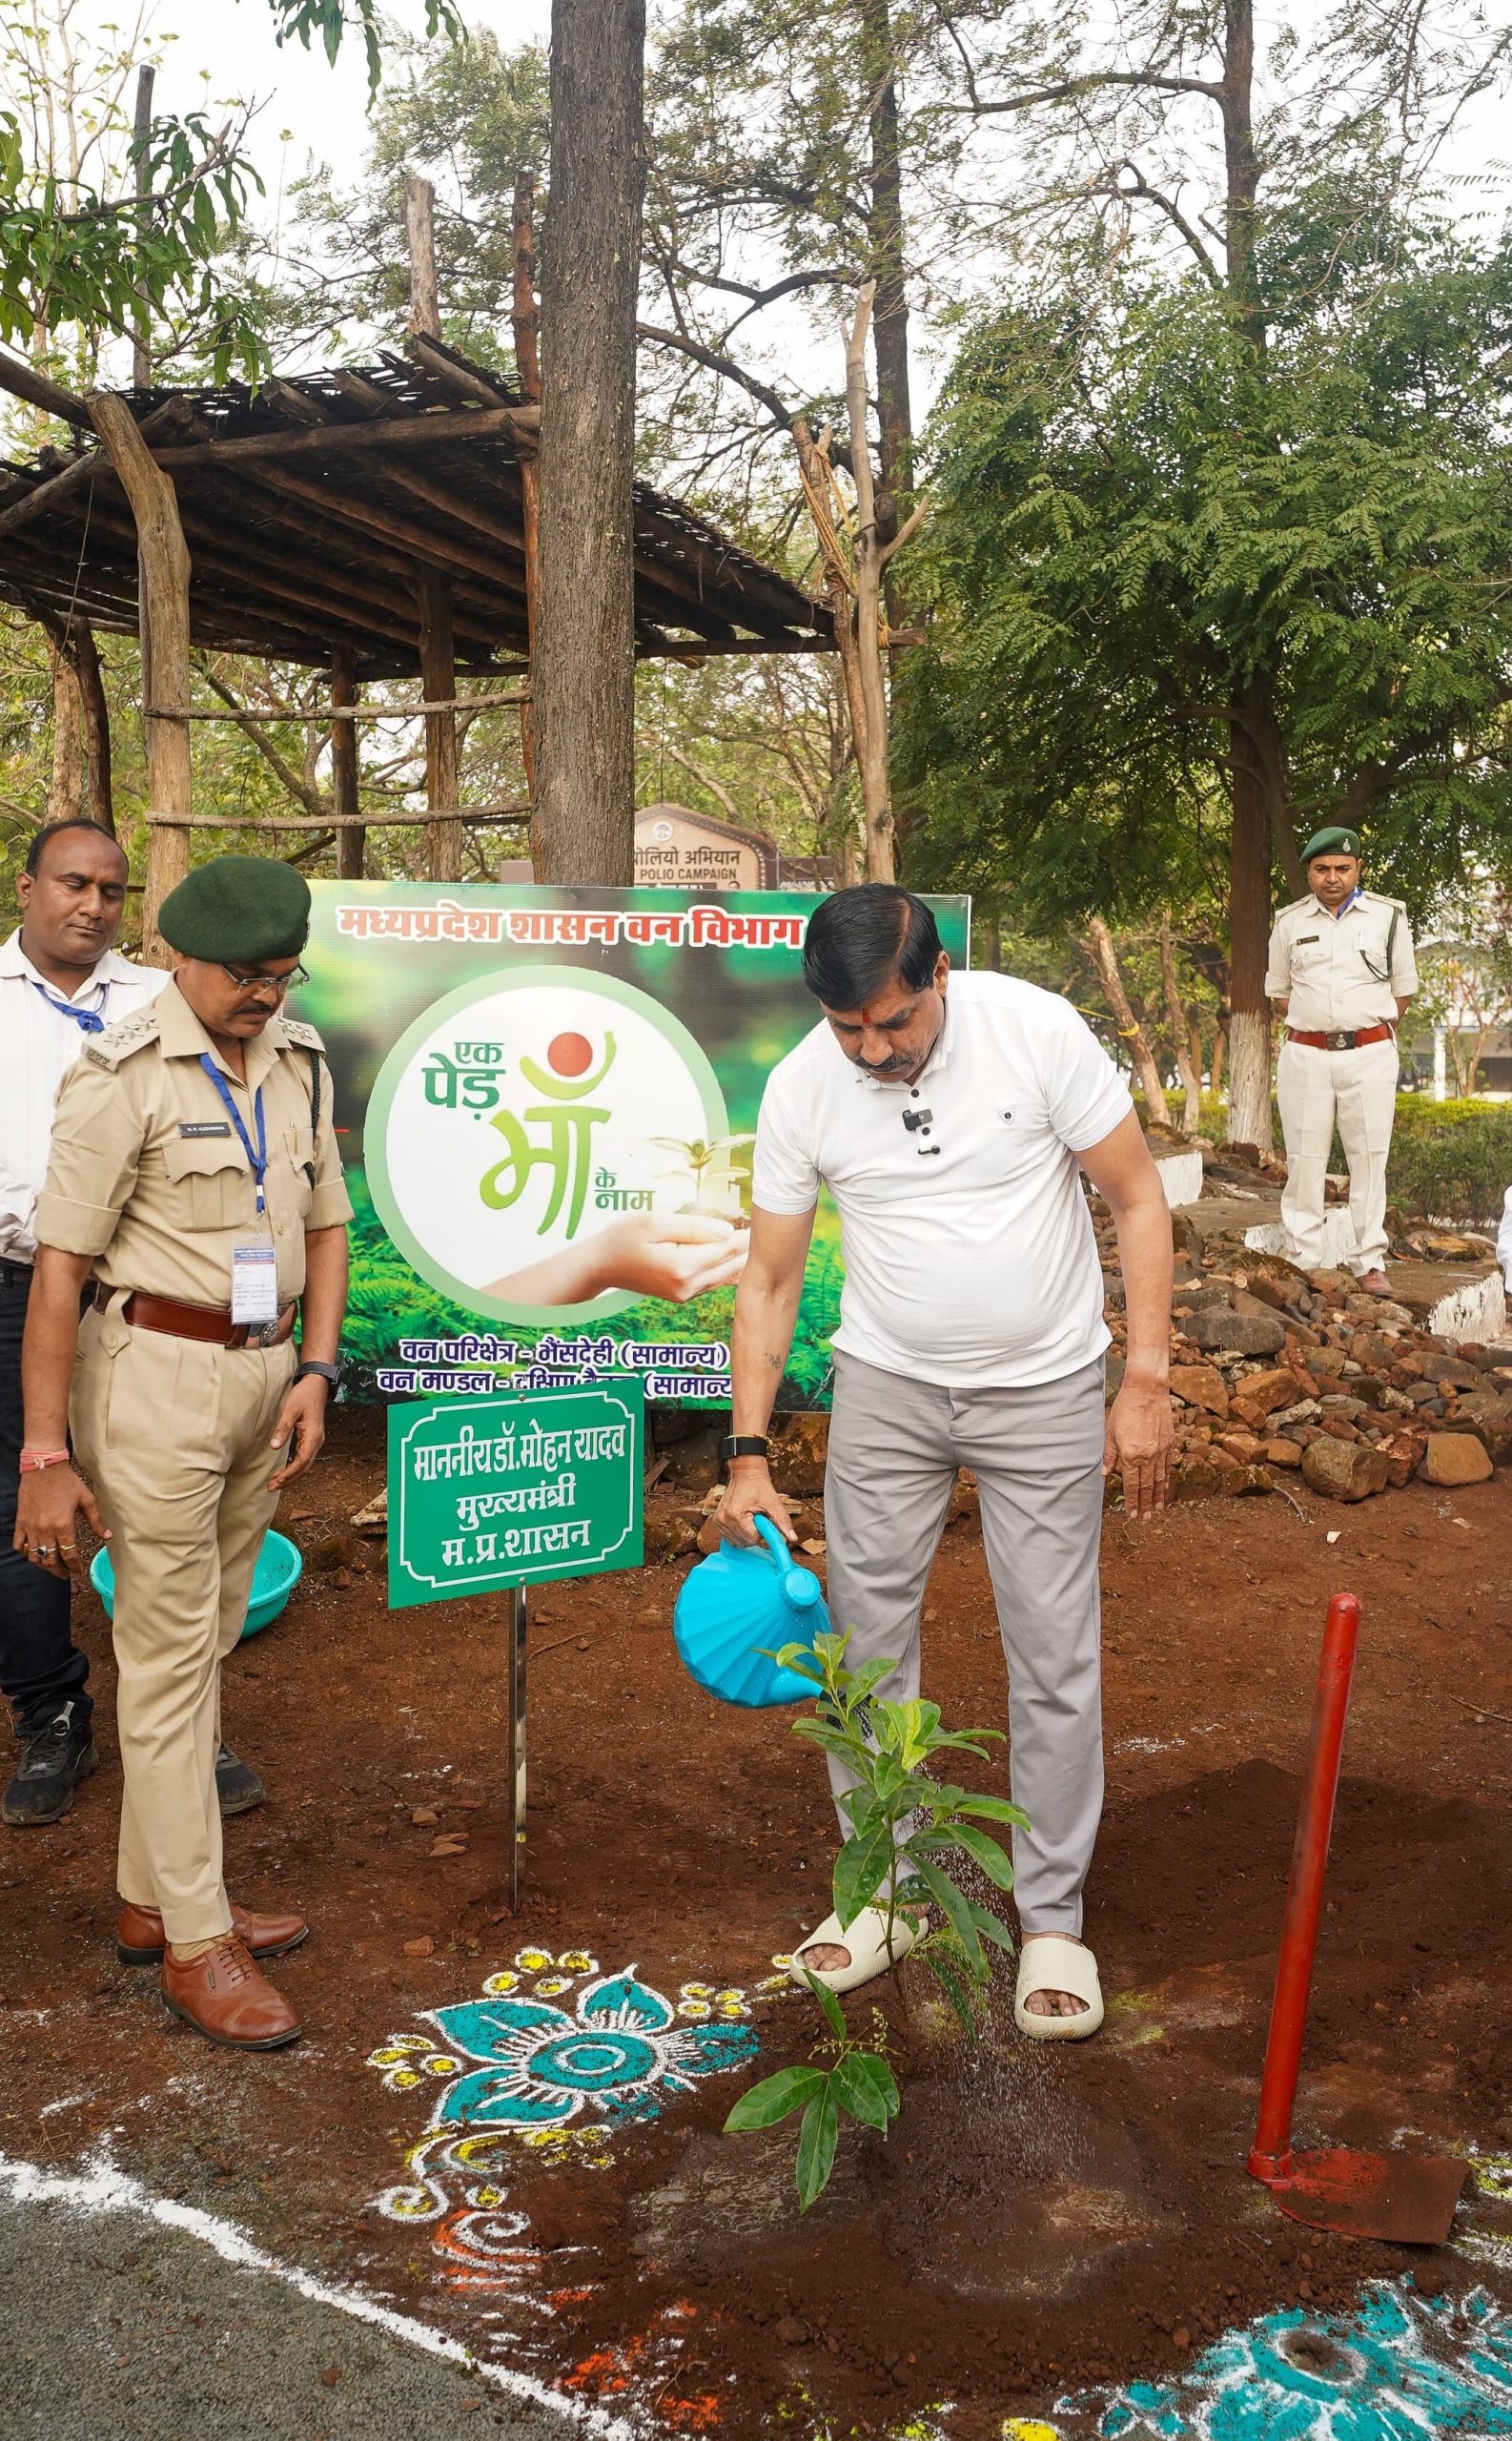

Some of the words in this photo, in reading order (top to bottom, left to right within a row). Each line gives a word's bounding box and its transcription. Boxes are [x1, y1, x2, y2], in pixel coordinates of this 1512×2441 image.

[684, 846, 741, 865] अभियान
[640, 869, 674, 880] POLIO
[678, 869, 737, 879] CAMPAIGN
[339, 902, 502, 939] मध्यप्रदेश
[509, 913, 619, 942] शासन
[626, 915, 684, 943] वन
[692, 909, 804, 945] विभाग
[454, 1041, 504, 1064] एक
[421, 1053, 506, 1121] पेड़
[595, 1167, 618, 1188] के
[595, 1190, 656, 1212] नाम
[401, 1341, 439, 1361] वन
[444, 1335, 515, 1362] परिक्षेत्र
[538, 1336, 615, 1364] भैंसदेही
[621, 1342, 727, 1368] (सामान्य)
[378, 1371, 416, 1390] वन
[421, 1372, 492, 1392] मण्डल
[644, 1372, 732, 1397] (सामान्य
[413, 1425, 493, 1481] माननीय
[574, 1424, 626, 1461] यादव
[456, 1472, 577, 1532] मुख्यमंत्री
